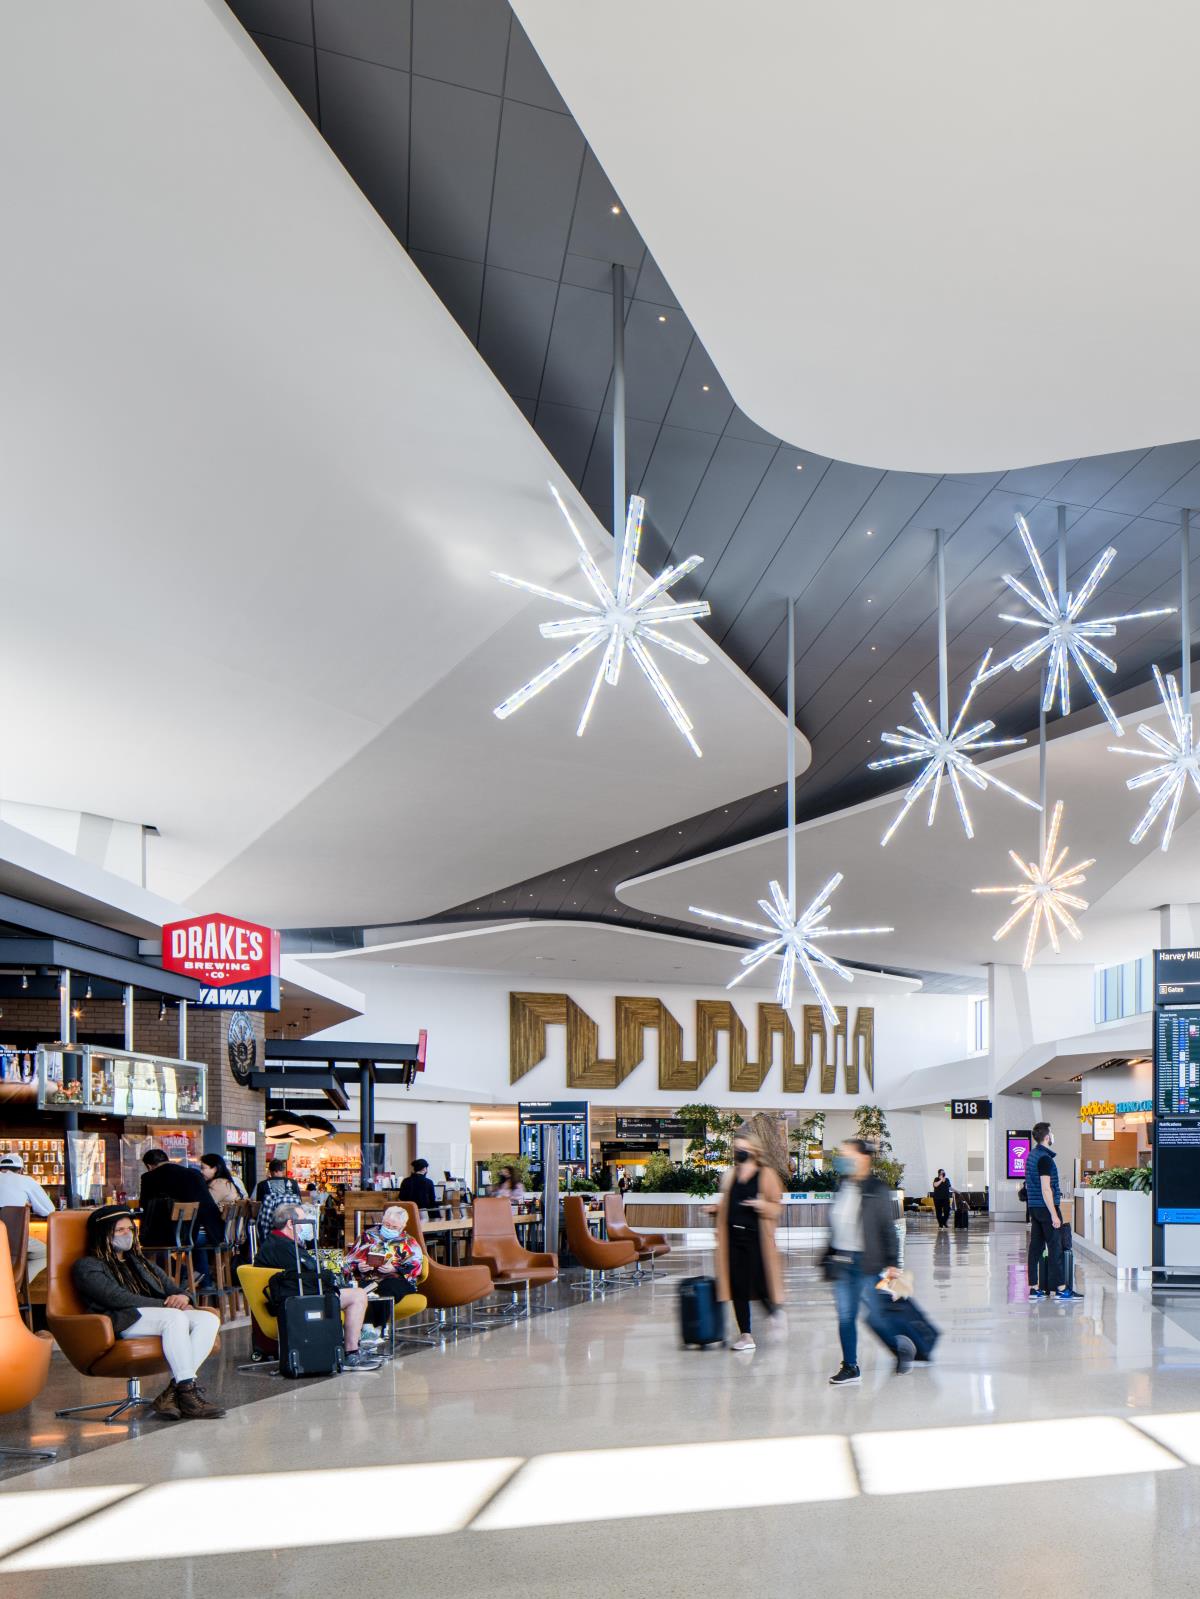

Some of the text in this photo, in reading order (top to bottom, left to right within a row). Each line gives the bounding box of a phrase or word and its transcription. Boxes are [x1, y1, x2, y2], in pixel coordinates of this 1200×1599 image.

[171, 922, 263, 961] DRAKE'S
[1159, 952, 1186, 962] Harvey
[184, 961, 251, 971] BREWING
[196, 988, 262, 1006] YAWAY
[954, 1102, 978, 1115] B18
[1080, 1100, 1116, 1123] goldilocks
